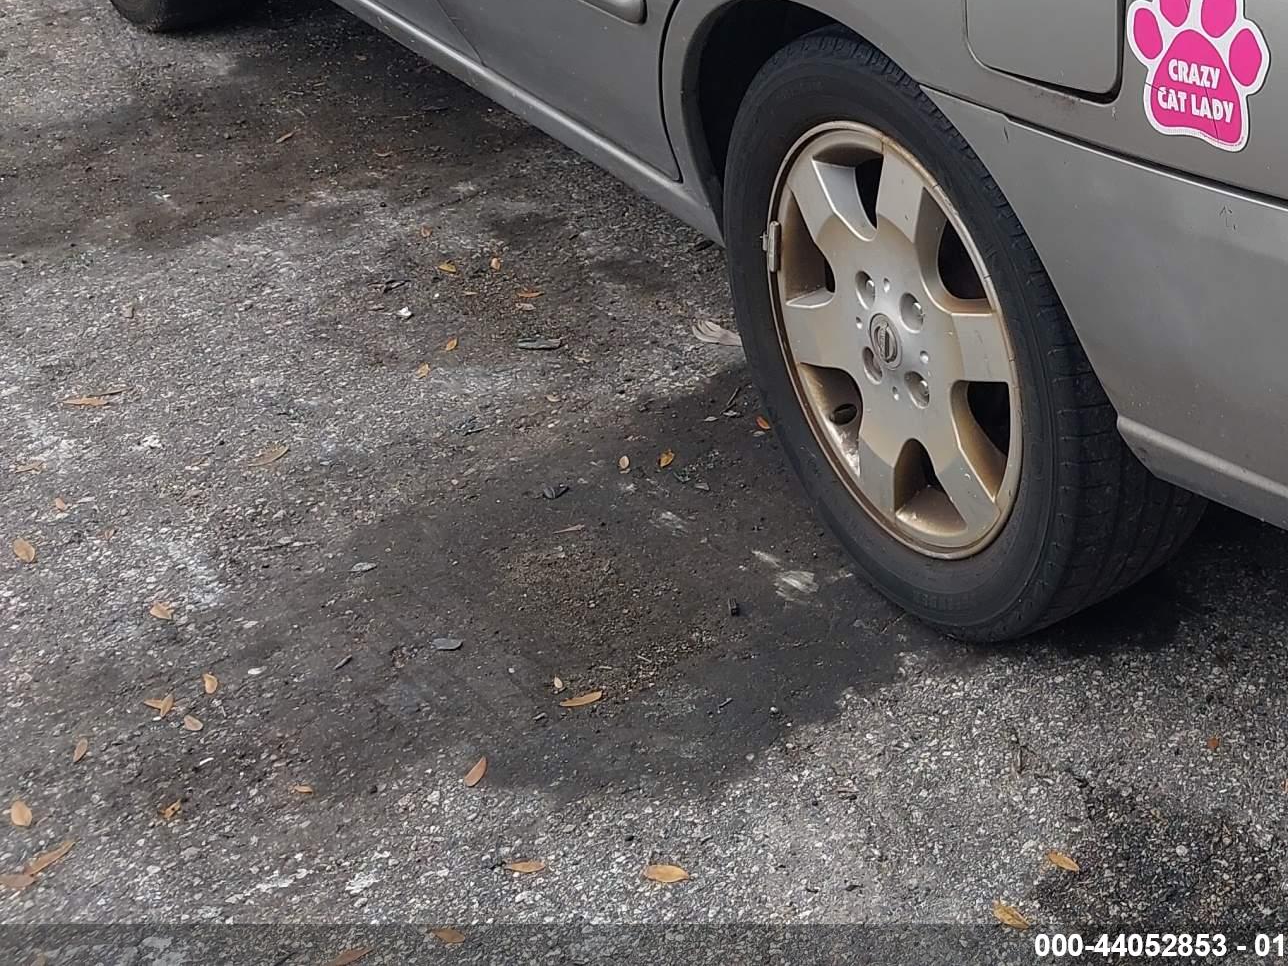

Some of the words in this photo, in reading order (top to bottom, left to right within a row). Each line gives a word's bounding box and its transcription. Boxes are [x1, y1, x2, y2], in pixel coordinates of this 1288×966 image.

[1168, 58, 1221, 89] CRAZY
[1157, 86, 1187, 113] CAT
[1190, 93, 1234, 123] LADY
